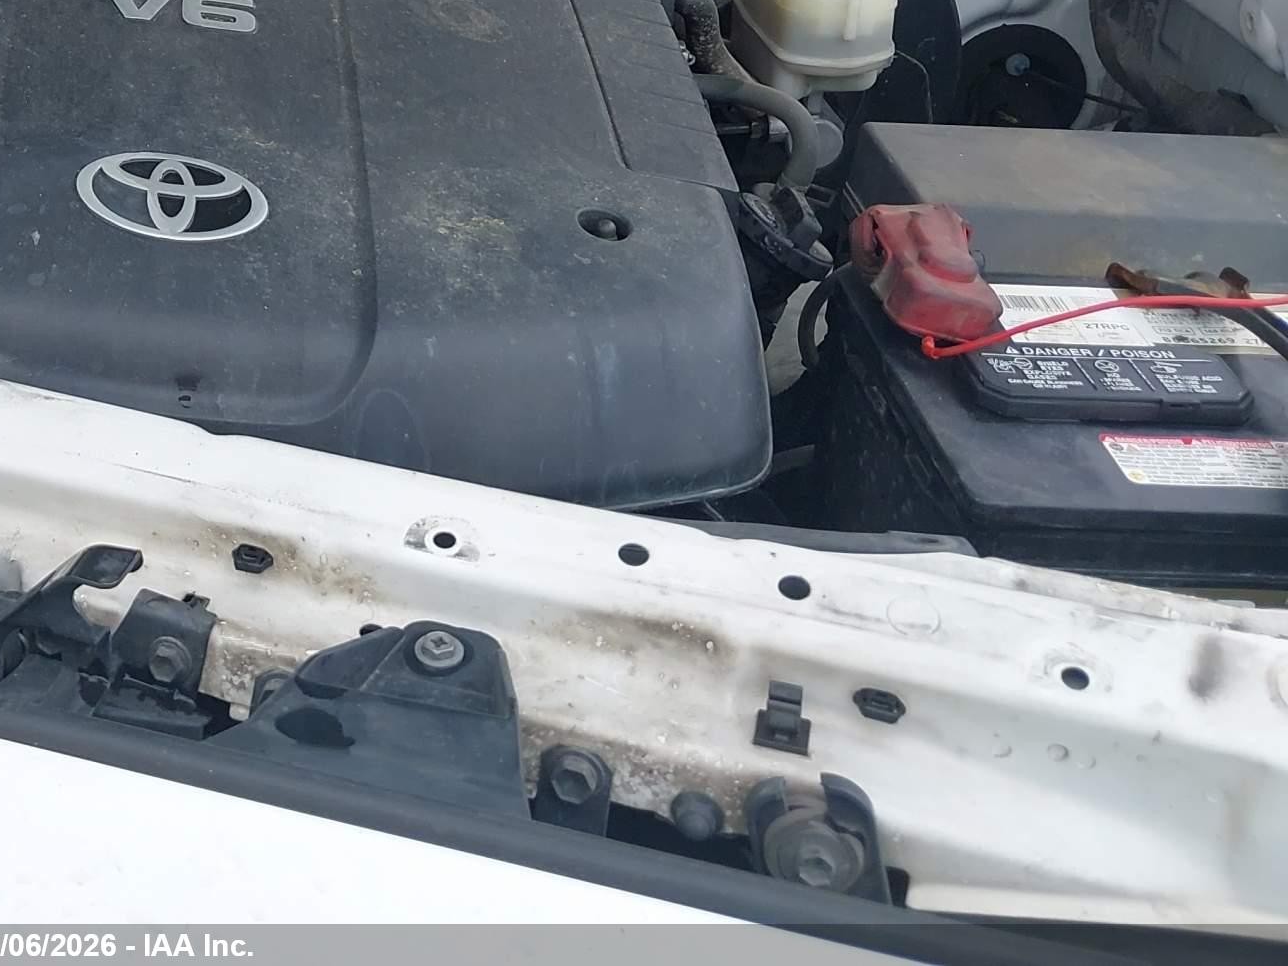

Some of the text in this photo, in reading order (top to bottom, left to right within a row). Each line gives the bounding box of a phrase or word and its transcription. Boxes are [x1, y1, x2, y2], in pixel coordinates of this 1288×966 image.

[1022, 346, 1176, 359] DANGER / POISON
